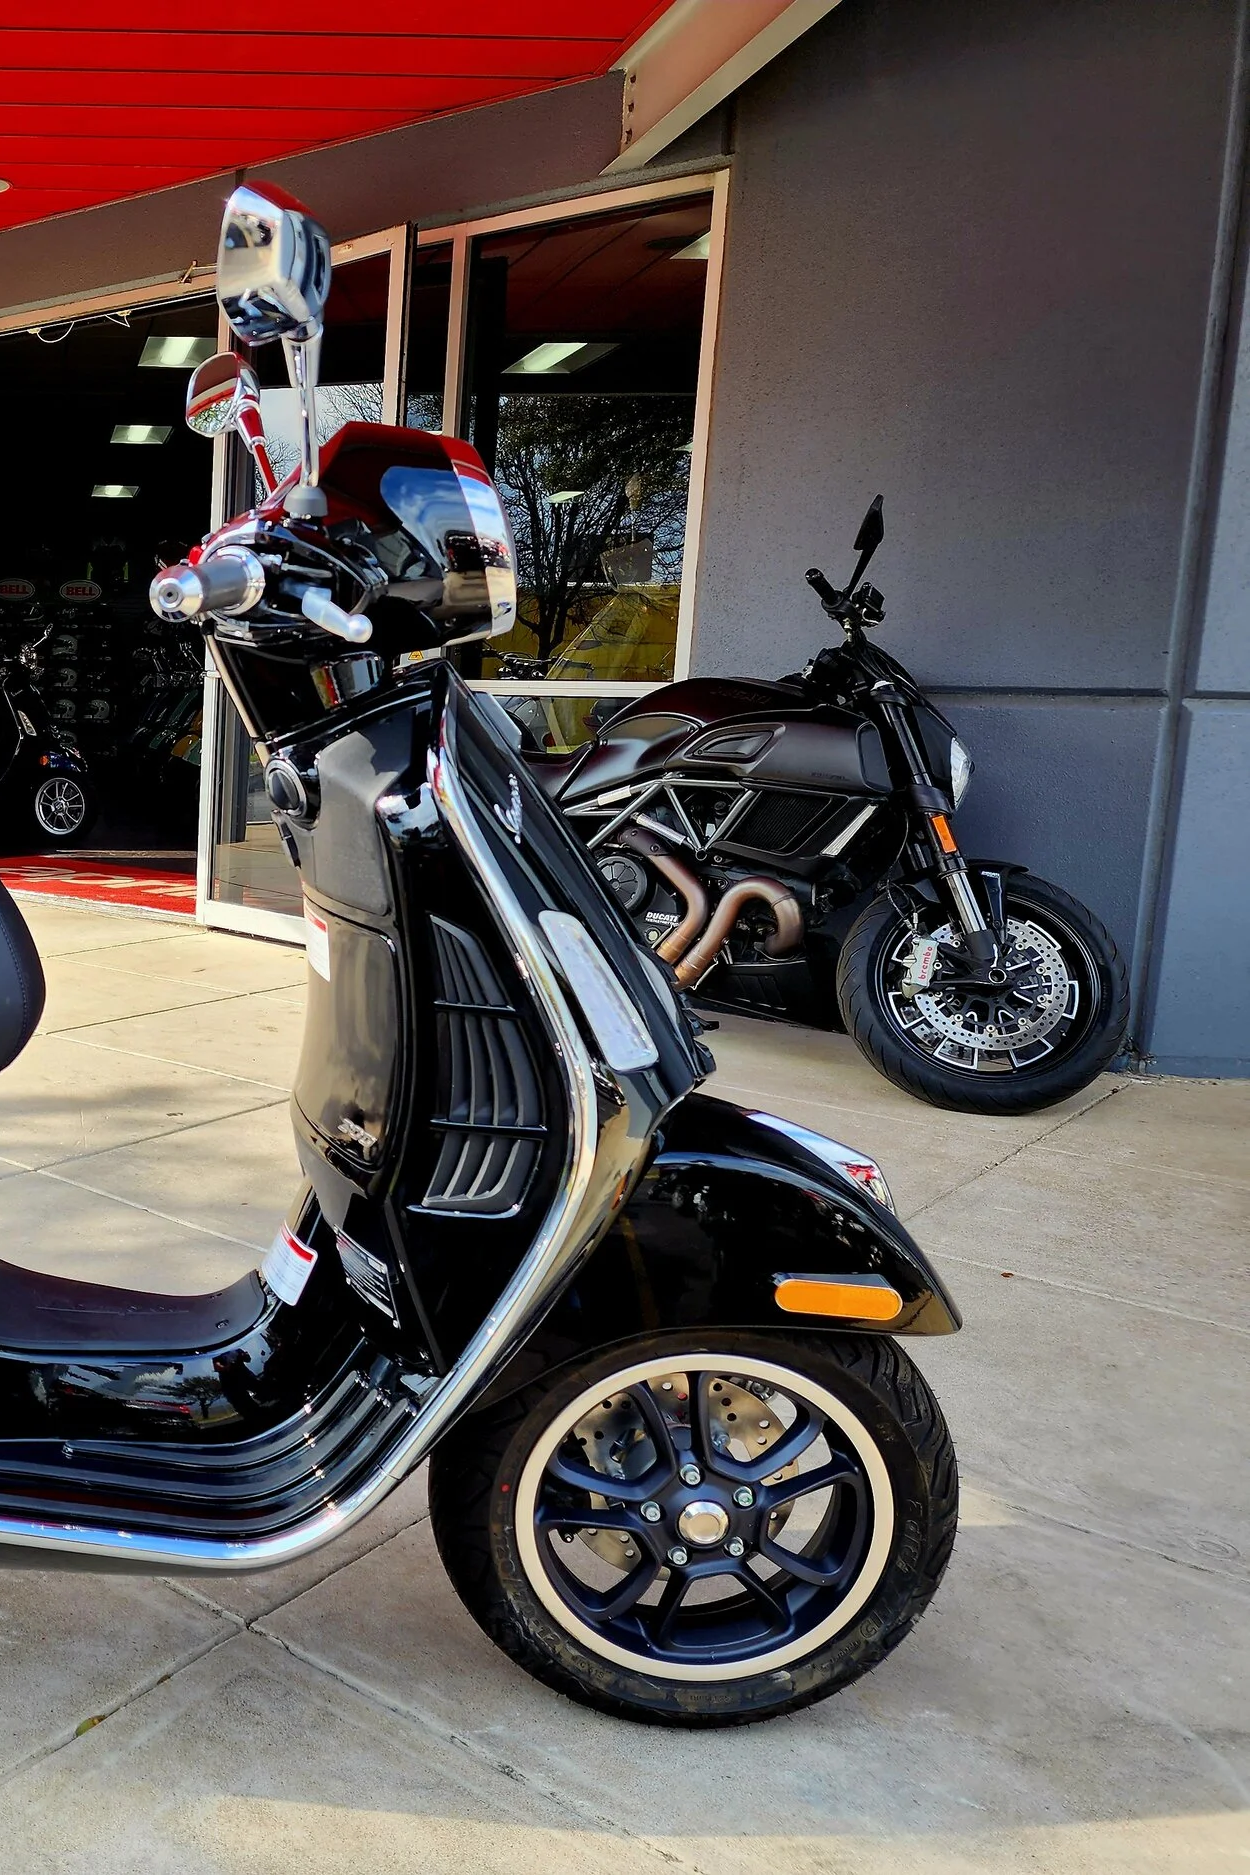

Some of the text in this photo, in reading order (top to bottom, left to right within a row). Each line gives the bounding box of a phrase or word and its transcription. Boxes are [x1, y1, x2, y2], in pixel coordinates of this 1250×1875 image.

[0, 584, 29, 595] BELL
[66, 586, 96, 596] BELL
[646, 911, 678, 922] DUCATI
[918, 946, 933, 980] brembo
